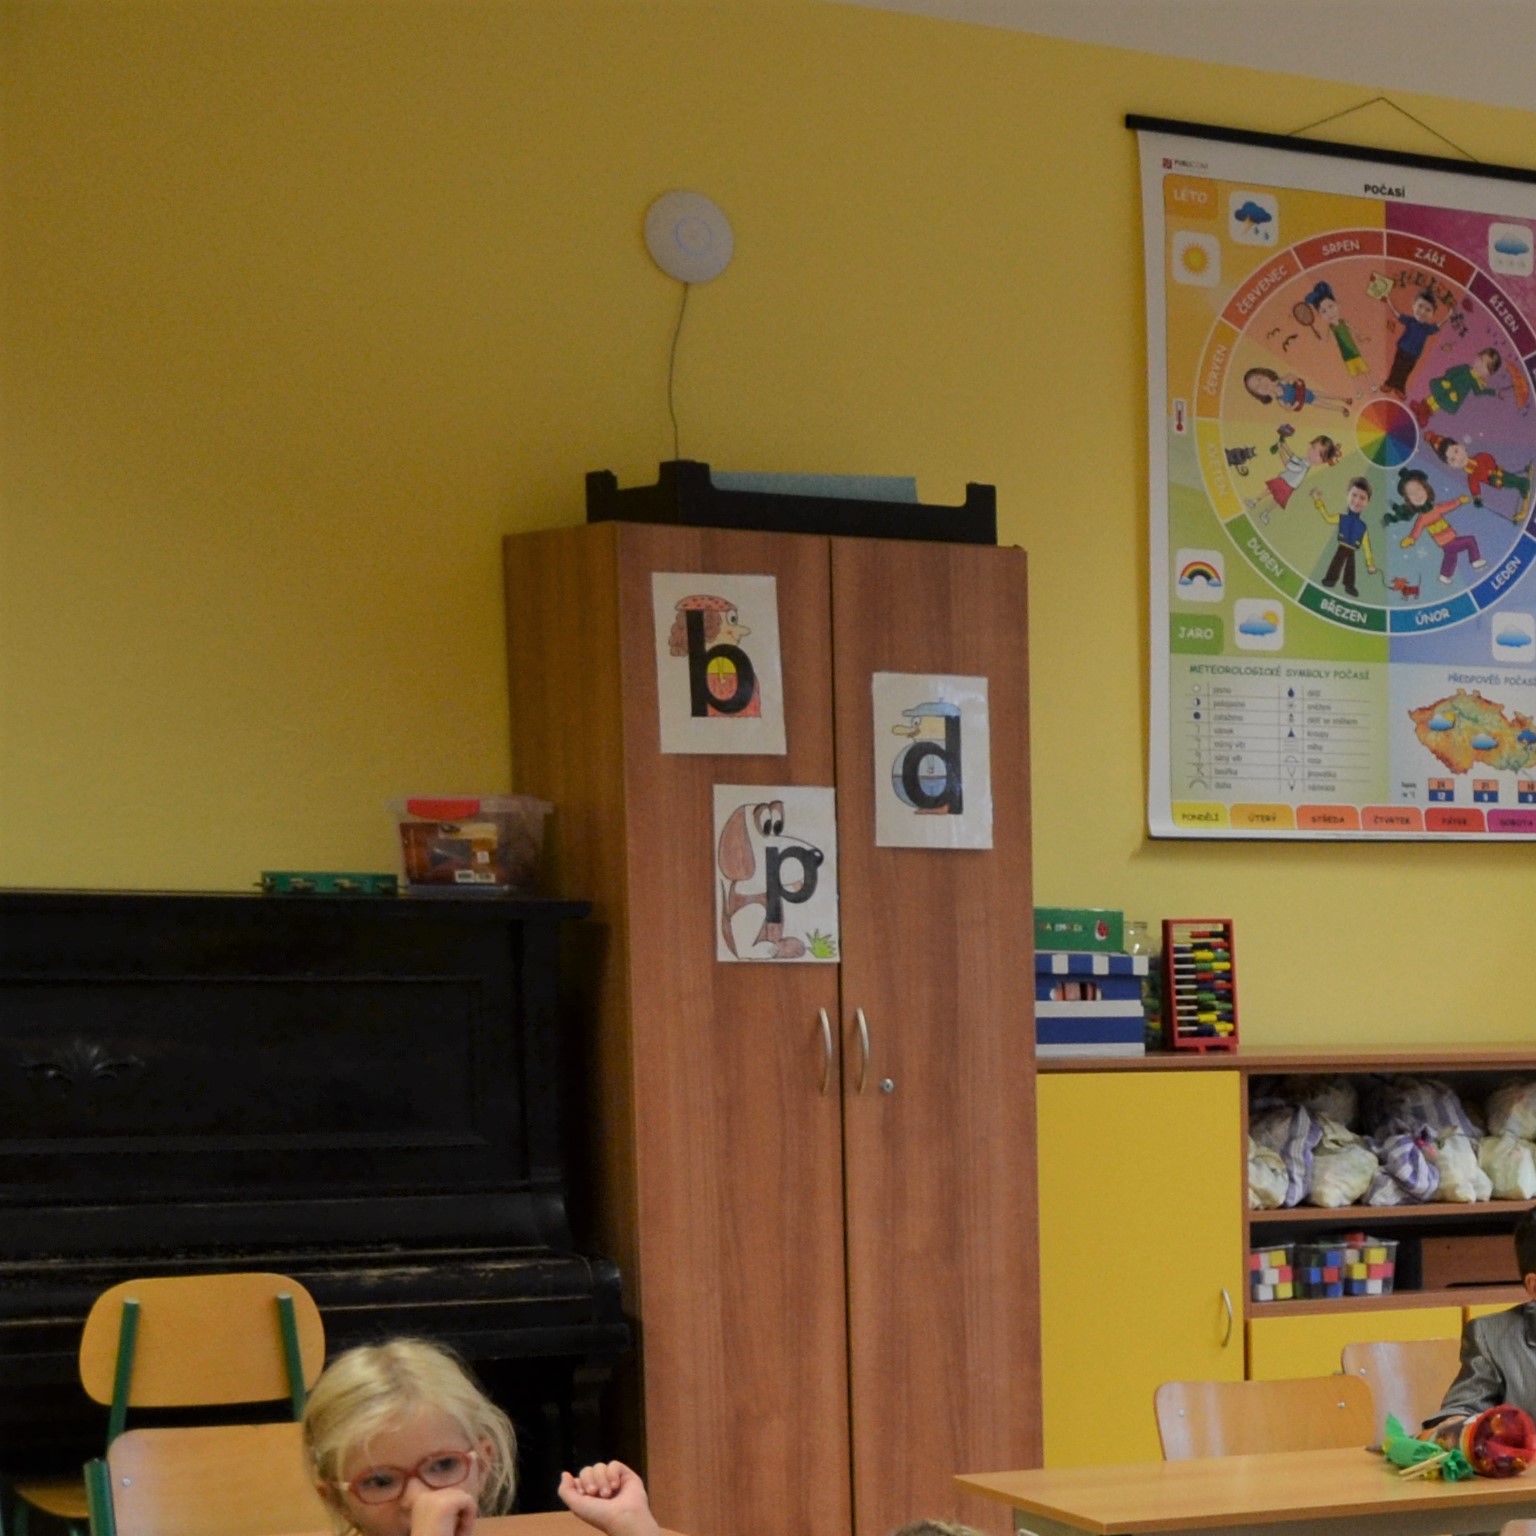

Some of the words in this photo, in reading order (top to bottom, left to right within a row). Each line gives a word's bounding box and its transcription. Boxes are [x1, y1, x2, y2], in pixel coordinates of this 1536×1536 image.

[1363, 182, 1406, 199] POČASÍ
[1321, 239, 1361, 256] SRPEN
[1414, 246, 1447, 269] ZÁŘÍ
[1236, 264, 1290, 316] ČERVENEC
[1245, 536, 1285, 580] DUBEN
[1489, 557, 1523, 592] LEDEN
[1319, 597, 1369, 625] BŘEZEN
[1414, 606, 1451, 627] ÚNOR
[1177, 625, 1214, 641] JARO
[686, 609, 755, 717] b
[1189, 664, 1282, 678] METEOROLOGICKÉ
[1285, 668, 1330, 680] SYMBOLY
[1333, 669, 1370, 681] POČASÍ
[902, 715, 963, 815] d
[765, 845, 819, 924] p
